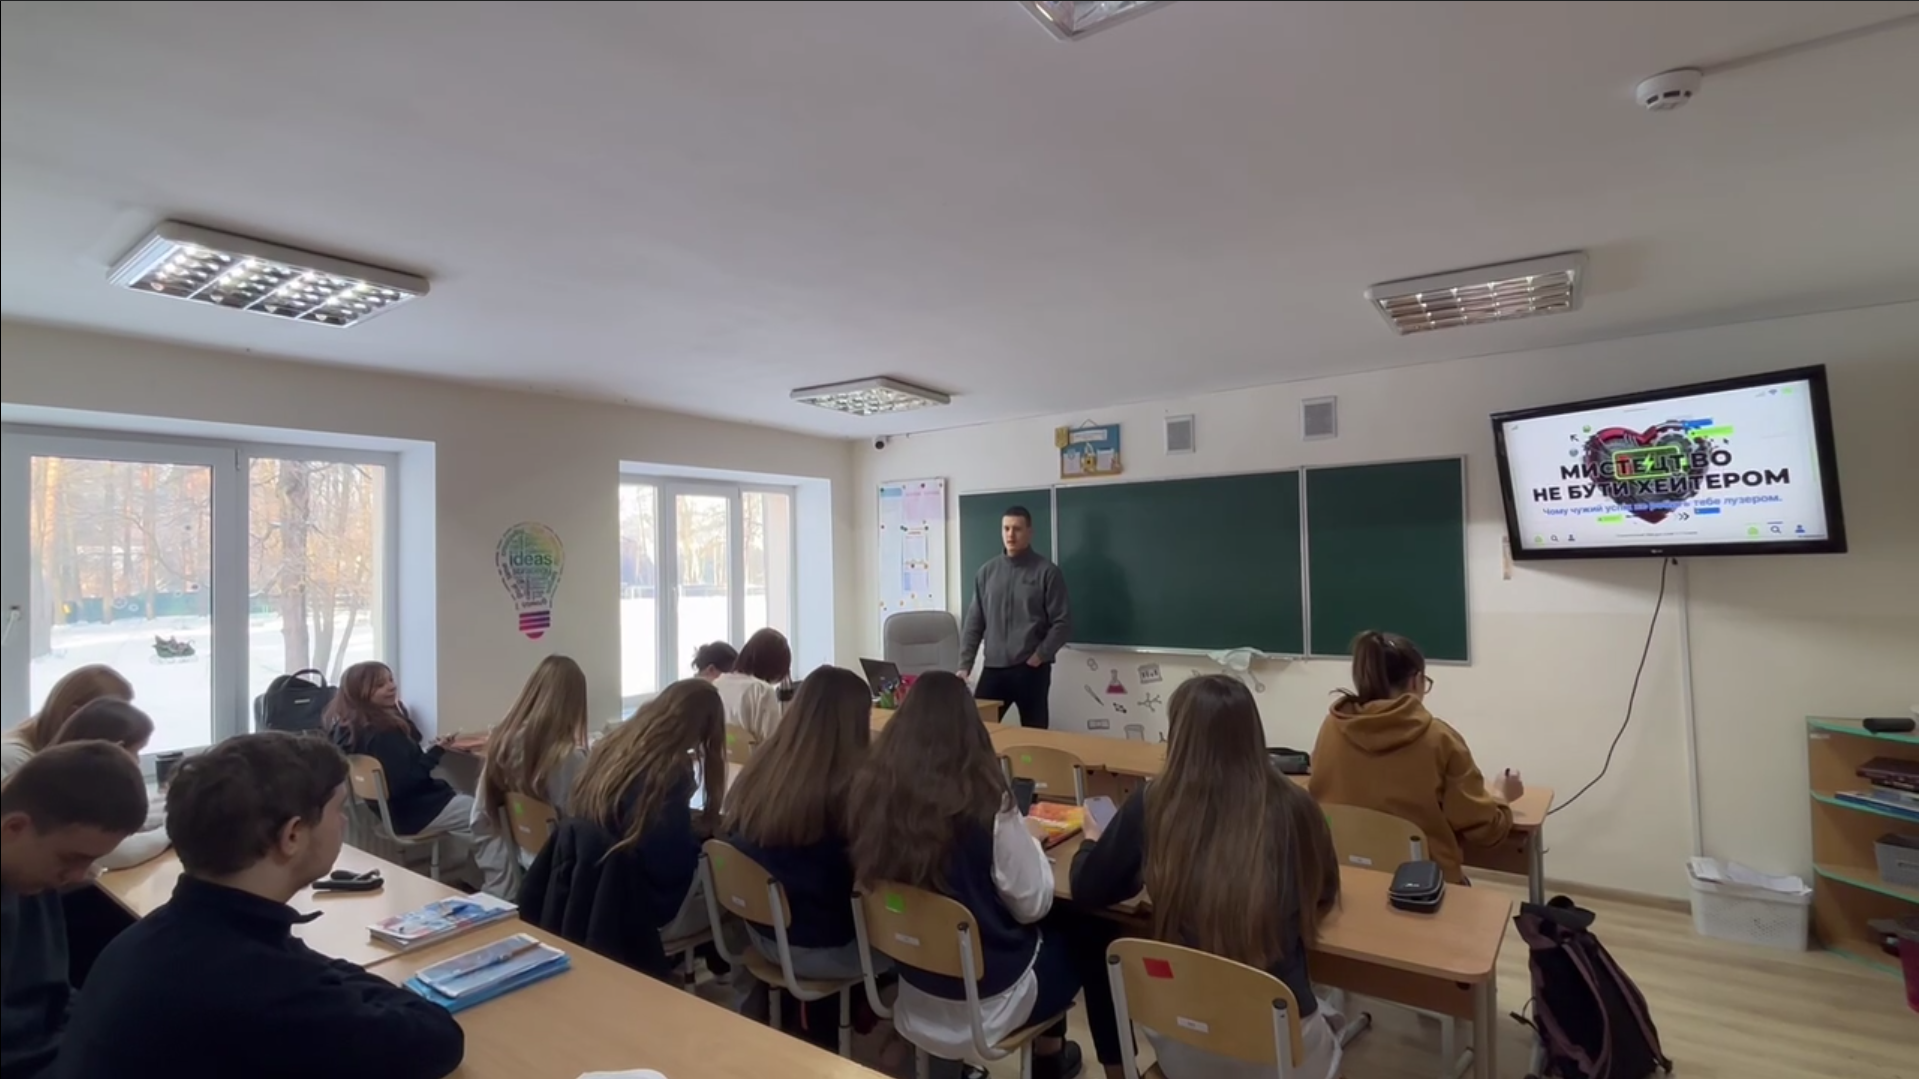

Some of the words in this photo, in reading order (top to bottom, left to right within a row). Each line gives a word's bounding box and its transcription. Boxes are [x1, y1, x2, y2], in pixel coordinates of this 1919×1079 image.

[1560, 449, 1732, 480] МИСТЕЦТВО
[1533, 486, 1562, 502] НЕ
[1567, 481, 1629, 500] БУТИ
[1638, 467, 1790, 494] ХЕЙТЕРОМ
[1543, 506, 1568, 516] Чому
[1571, 505, 1603, 515] чужий
[1694, 497, 1722, 507] тебе
[1724, 494, 1782, 507] лузером.
[509, 551, 553, 566] ideas
